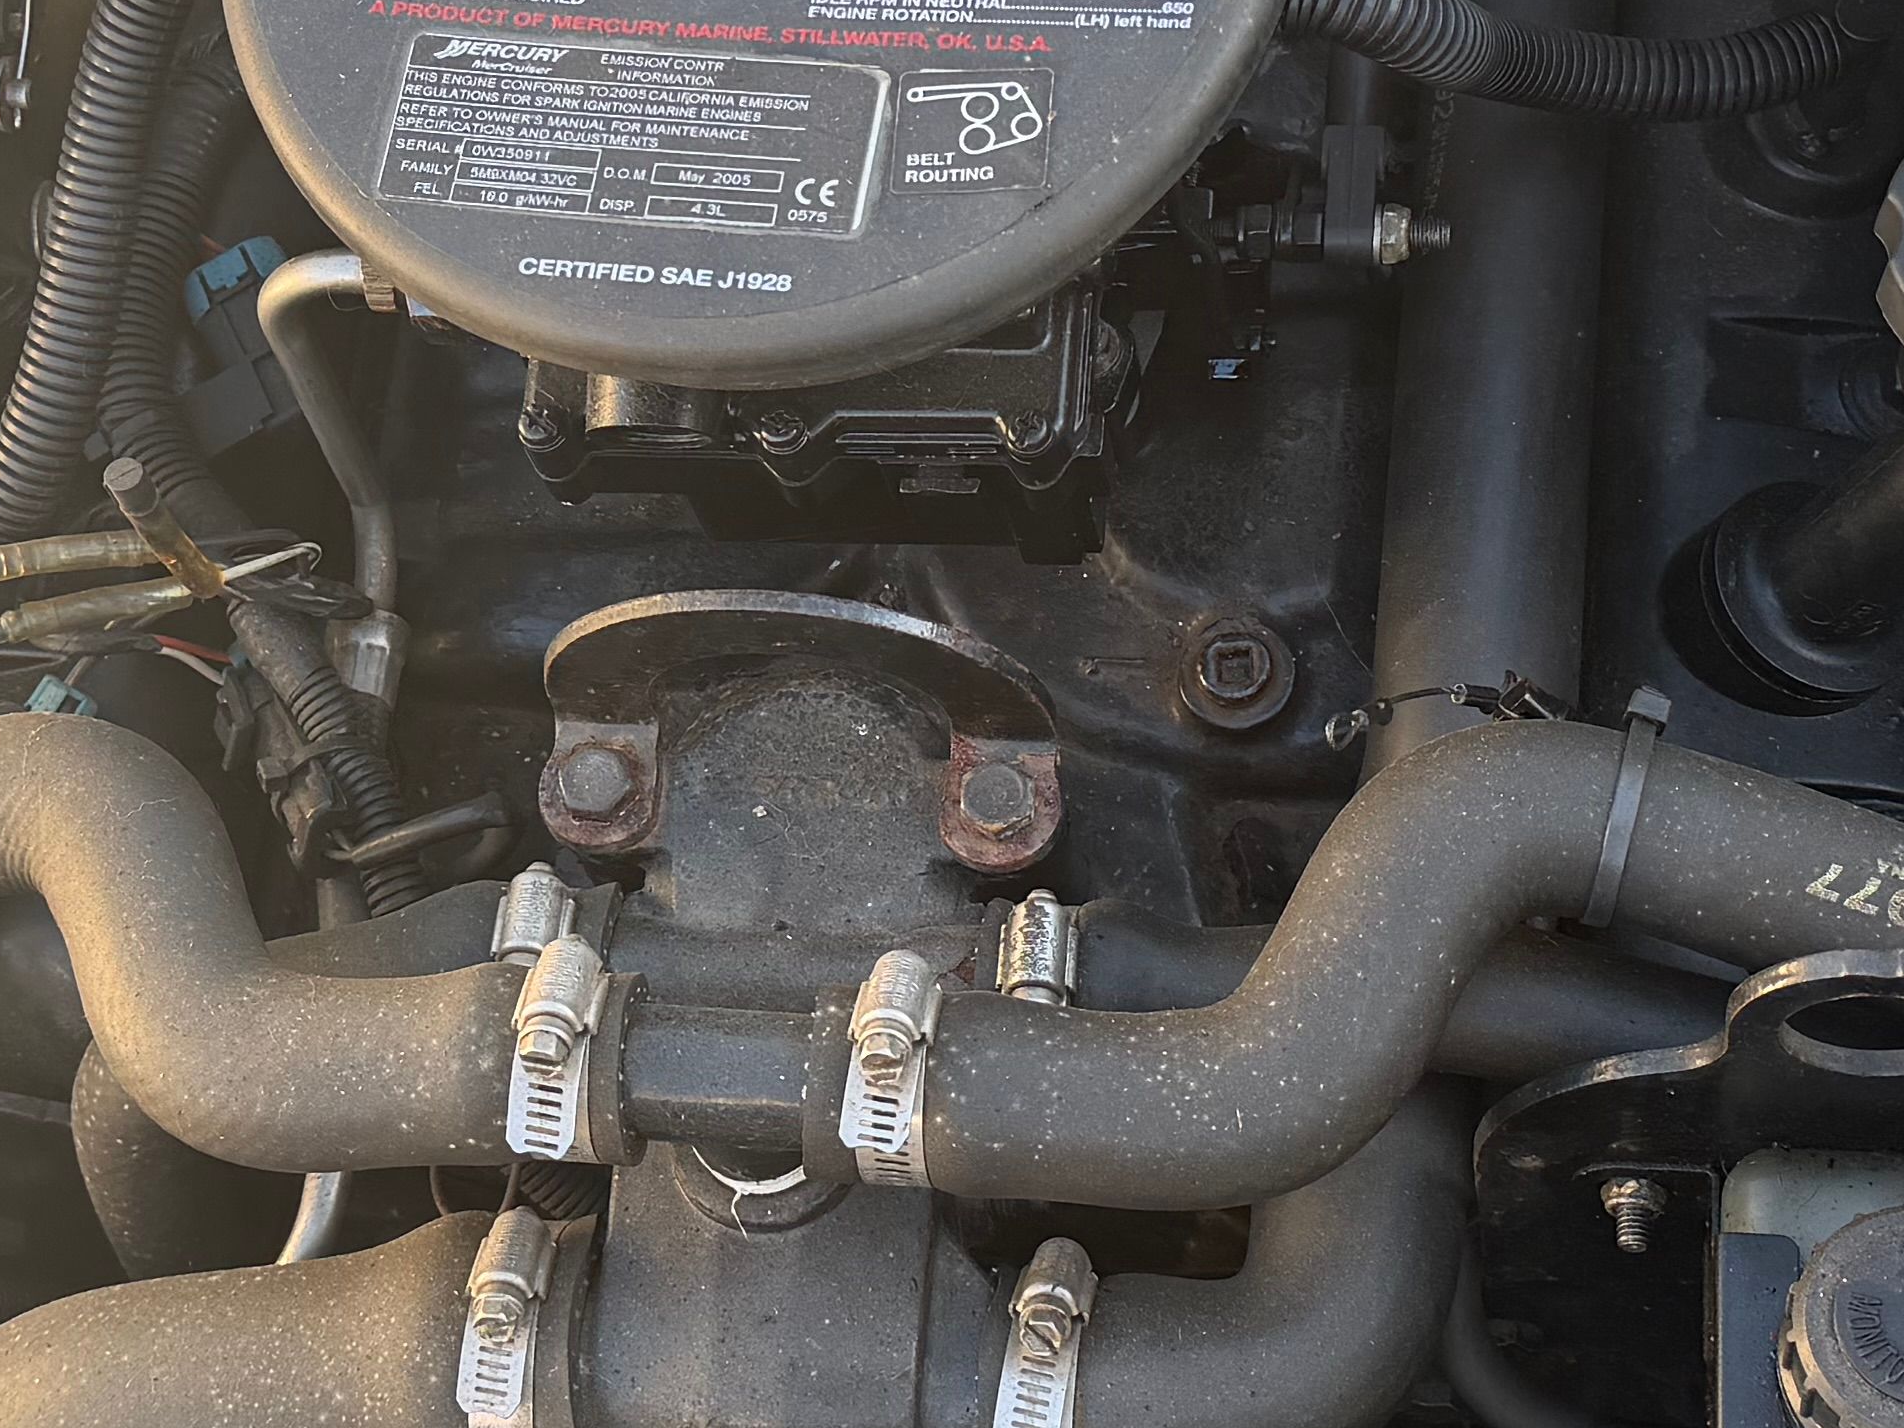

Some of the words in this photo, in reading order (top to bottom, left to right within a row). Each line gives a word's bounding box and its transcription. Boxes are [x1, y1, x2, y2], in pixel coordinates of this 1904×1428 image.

[1161, 2, 1194, 14] 650
[808, 6, 878, 20] ENGINE
[881, 8, 974, 23] ROTATION
[1074, 13, 1111, 29] (LH)
[1114, 14, 1143, 28] left
[1146, 15, 1192, 29] hand
[369, 0, 386, 14] A
[391, 0, 509, 26] PRODUCT
[513, 11, 546, 29] OF
[552, 14, 671, 38] MERCURY
[985, 34, 1056, 54] U.S.A.
[433, 39, 569, 63] MERCURY
[472, 59, 553, 75] MerCruiser
[600, 53, 672, 69] EMISSION
[407, 70, 438, 83] THIS
[441, 73, 497, 89] ENGINE
[500, 79, 584, 96] CONFORMS
[648, 91, 734, 107] CALIFORNIA
[739, 95, 809, 112] EMISSION
[404, 84, 499, 103] REGULATIONS
[502, 93, 532, 106] FOR
[534, 96, 580, 110] SPARK
[583, 100, 643, 115] IGNITION
[645, 103, 697, 119] MARINE
[701, 107, 762, 123] ENGINES
[400, 102, 448, 118] REFER
[452, 107, 473, 119] TO
[475, 109, 543, 126] OWNER'S
[547, 115, 607, 131] MANUAL
[611, 120, 640, 133] FOR
[645, 123, 749, 141] MAINTENANCE
[395, 115, 515, 138] SPECIFICATIONS
[518, 127, 550, 140] AND
[553, 130, 659, 148] ADJUSTMENTS
[395, 138, 450, 154] SERIAL
[400, 160, 453, 176] FAMILY
[906, 153, 955, 167] BELT
[679, 170, 705, 184] May
[713, 173, 752, 186] 2005
[904, 166, 994, 183] ROUTING
[413, 182, 441, 195] FEL
[795, 178, 840, 207] CE
[599, 198, 636, 213] DISP.
[690, 203, 726, 217] 4.3L
[787, 210, 828, 223] 0575
[518, 257, 655, 284] CERTIFIED
[660, 267, 714, 288] SAE
[718, 270, 793, 292] J1928
